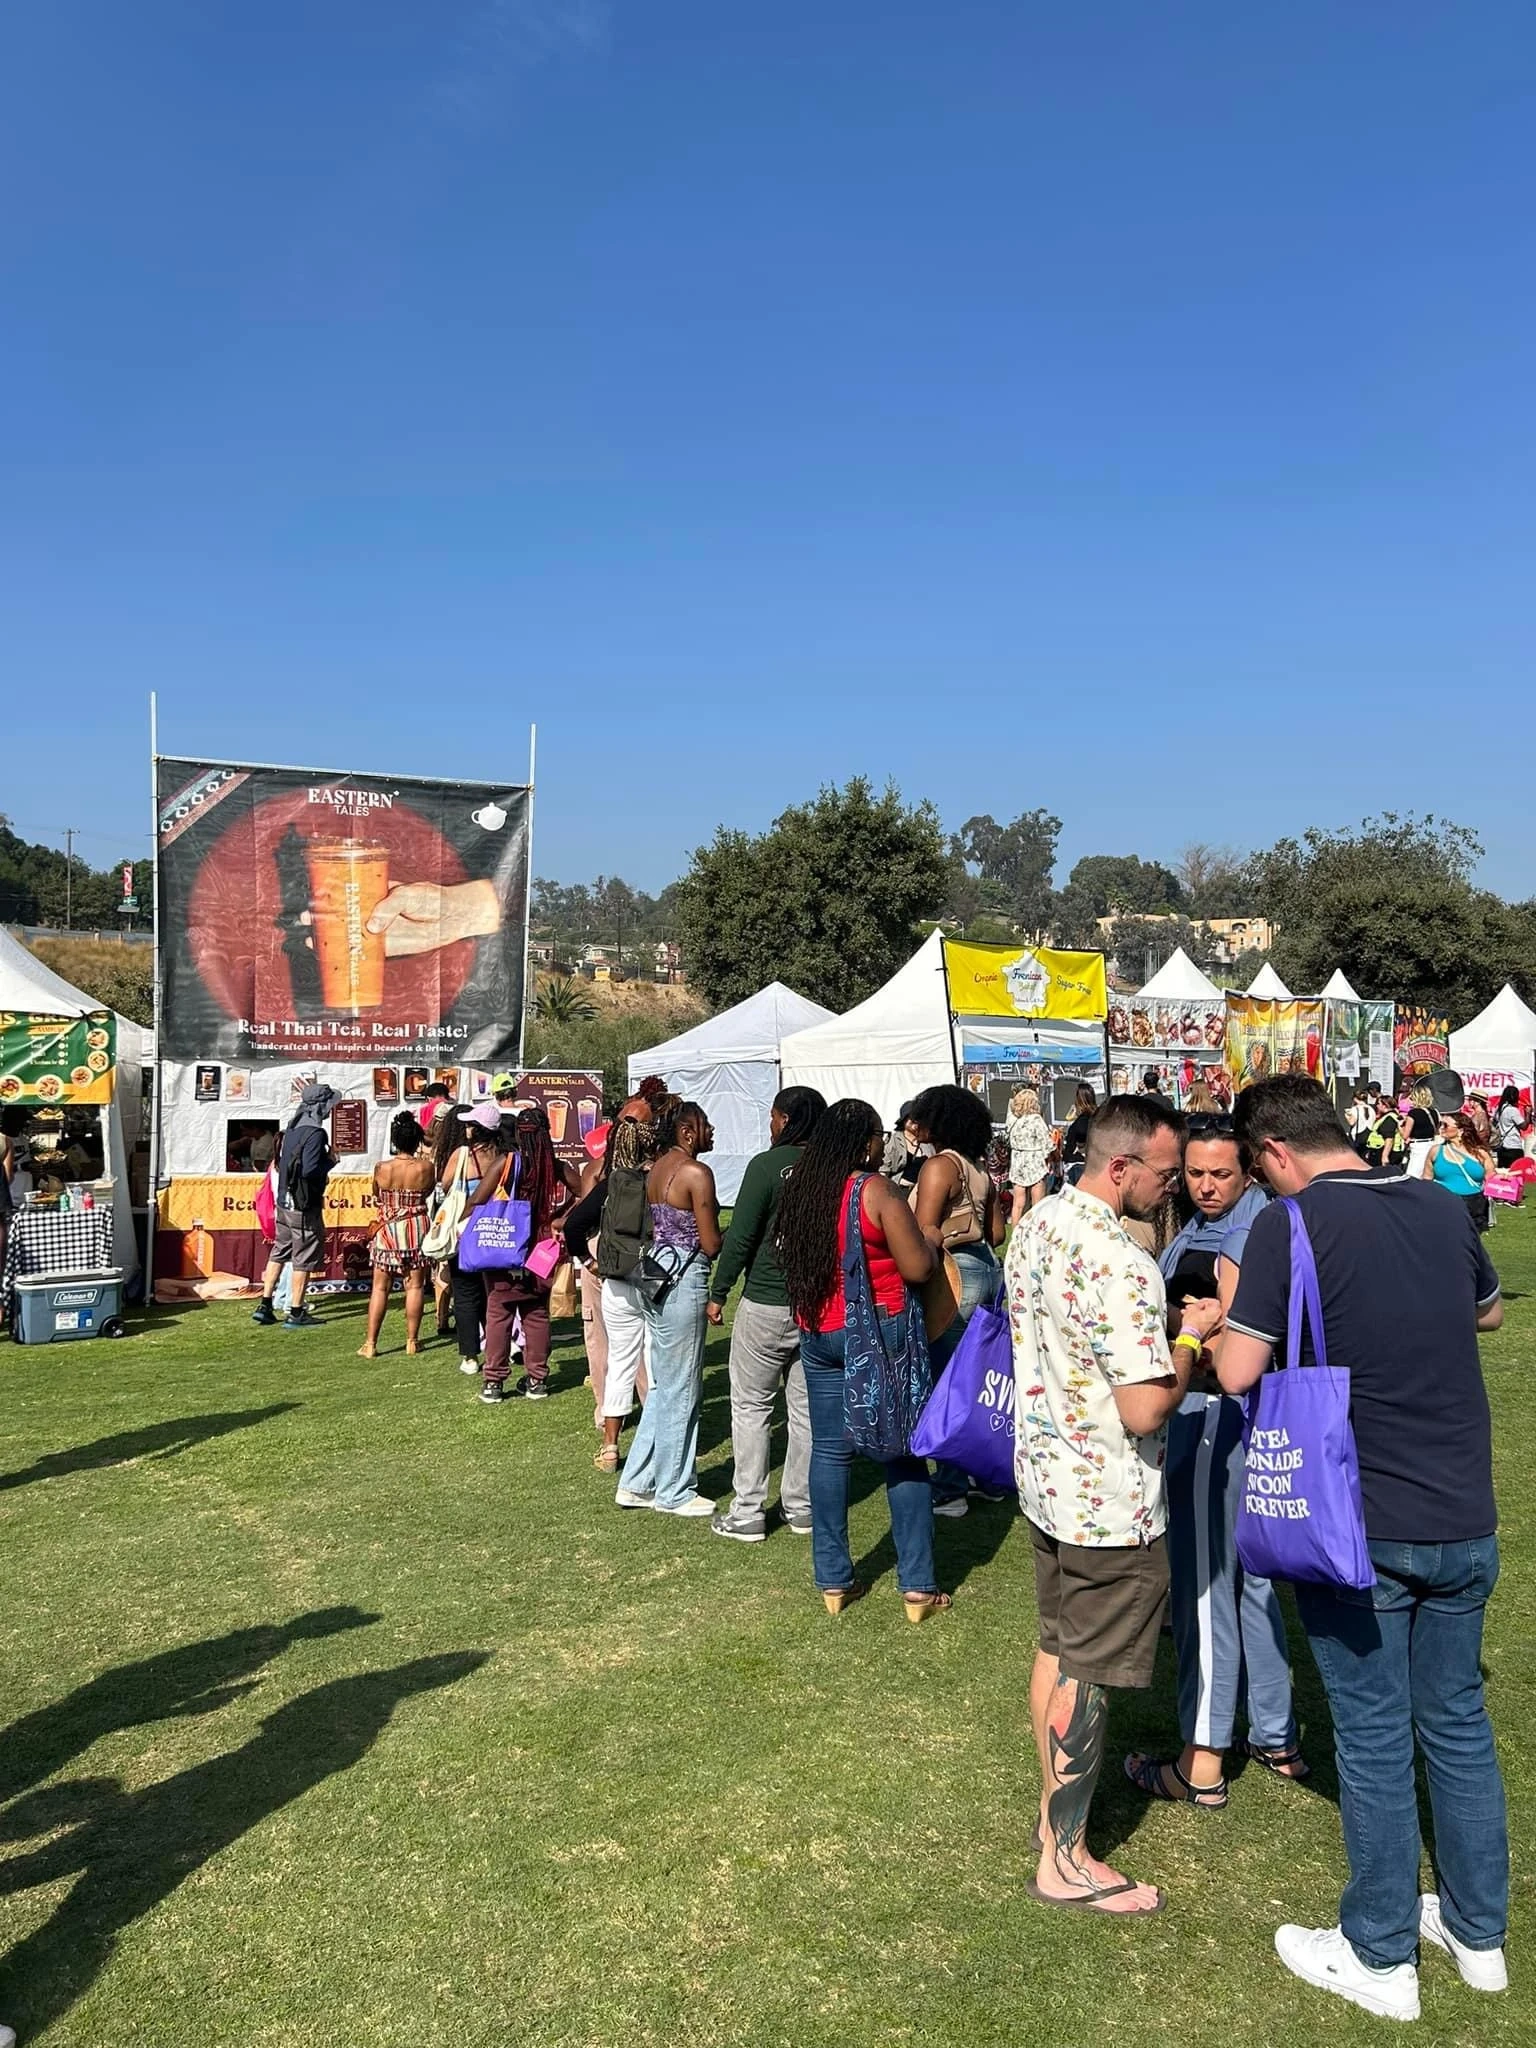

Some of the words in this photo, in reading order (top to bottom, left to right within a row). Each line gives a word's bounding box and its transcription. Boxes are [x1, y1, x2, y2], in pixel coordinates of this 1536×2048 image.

[308, 788, 394, 809] EASTERN
[334, 805, 370, 816] TALES
[238, 1018, 276, 1036] Real
[281, 1021, 322, 1036] Thai
[328, 1021, 366, 1038] Tea,
[372, 1022, 410, 1038] Real
[416, 1023, 468, 1039] Taste!
[311, 1042, 331, 1051] Thai
[374, 1044, 413, 1052] Desserts
[528, 1076, 569, 1085] EASTERN
[223, 1197, 257, 1211] Rea
[492, 1217, 510, 1225] TEA
[473, 1224, 516, 1233] LEMONADE
[479, 1232, 510, 1241] SWOON
[478, 1240, 517, 1248] FOREVER
